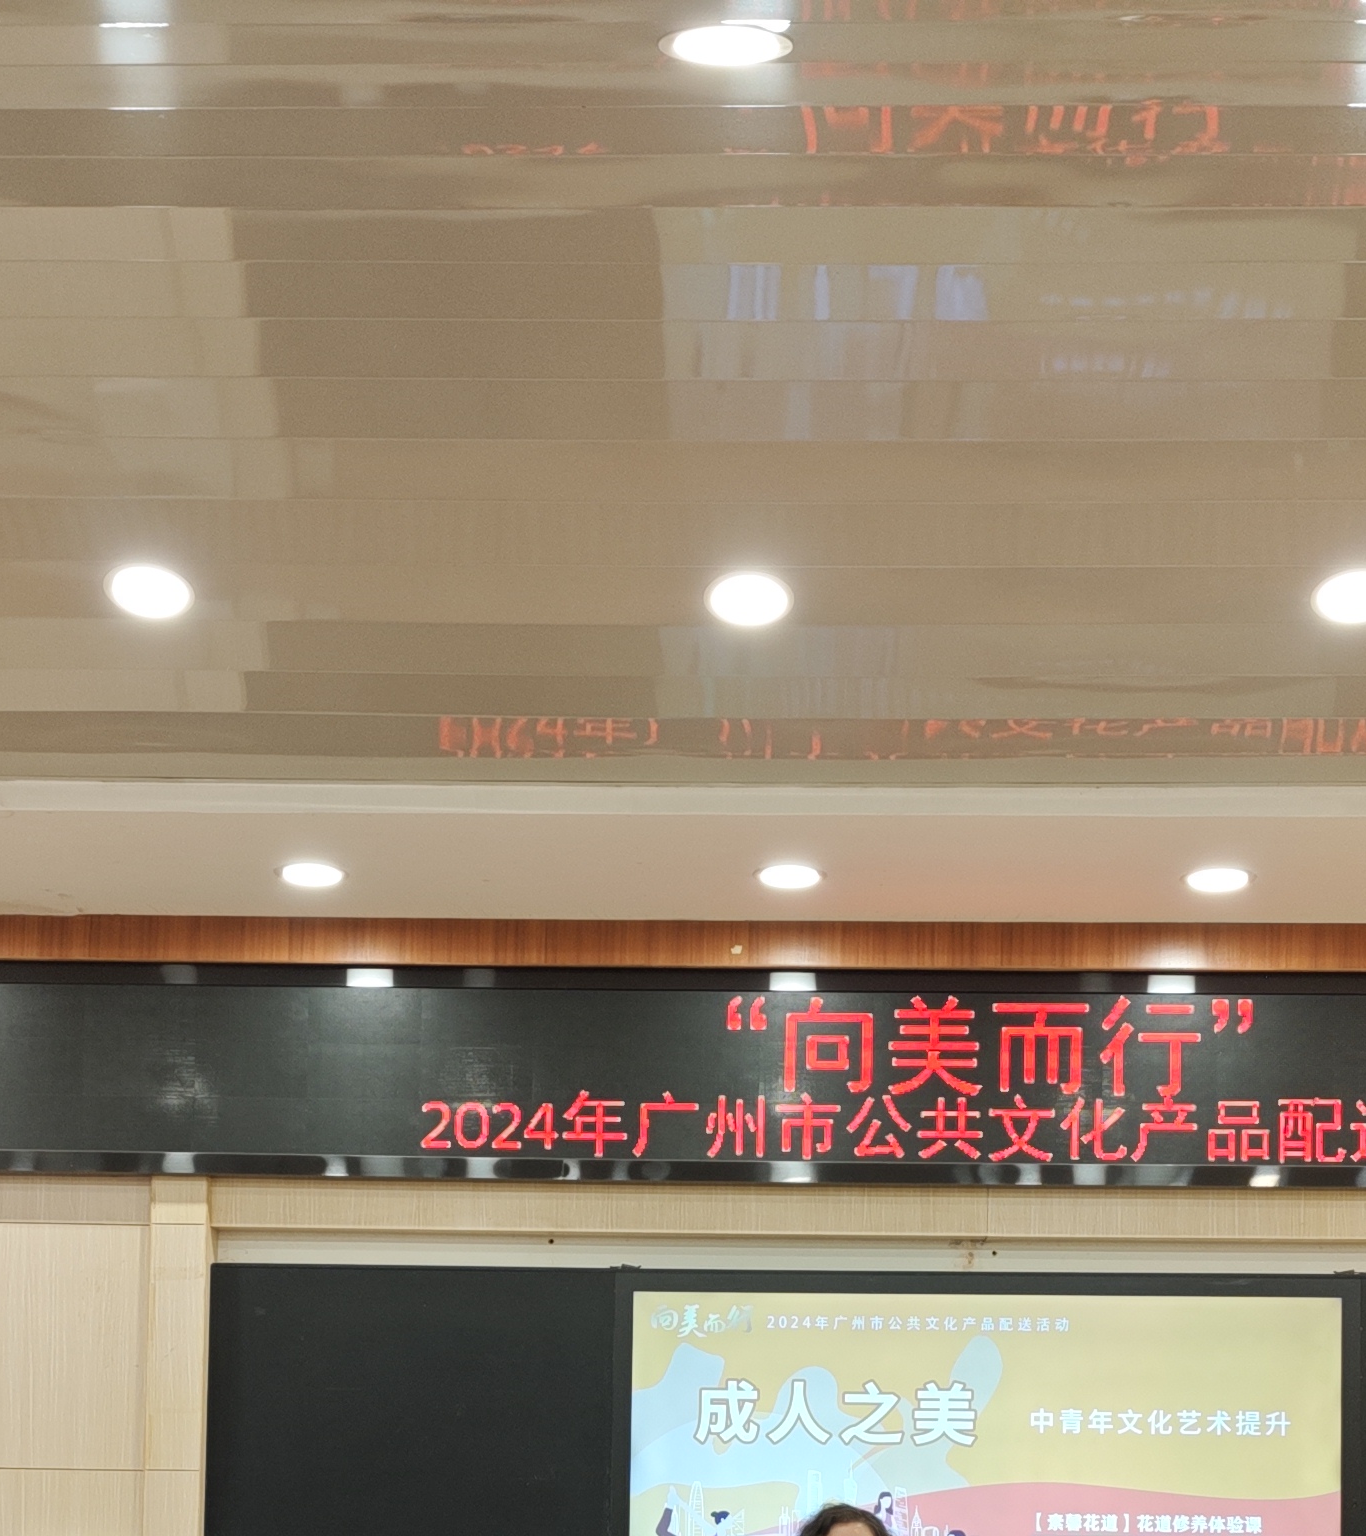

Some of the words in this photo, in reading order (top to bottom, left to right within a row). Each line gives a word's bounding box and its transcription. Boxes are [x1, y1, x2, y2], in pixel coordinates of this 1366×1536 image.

[726, 996, 1254, 1097] “向美而行”
[766, 1314, 1071, 1333] 2024年广州市公共文化产品配送活动
[693, 1378, 978, 1447] 成人之美
[1029, 1407, 1292, 1437] 中青年文化艺术提升
